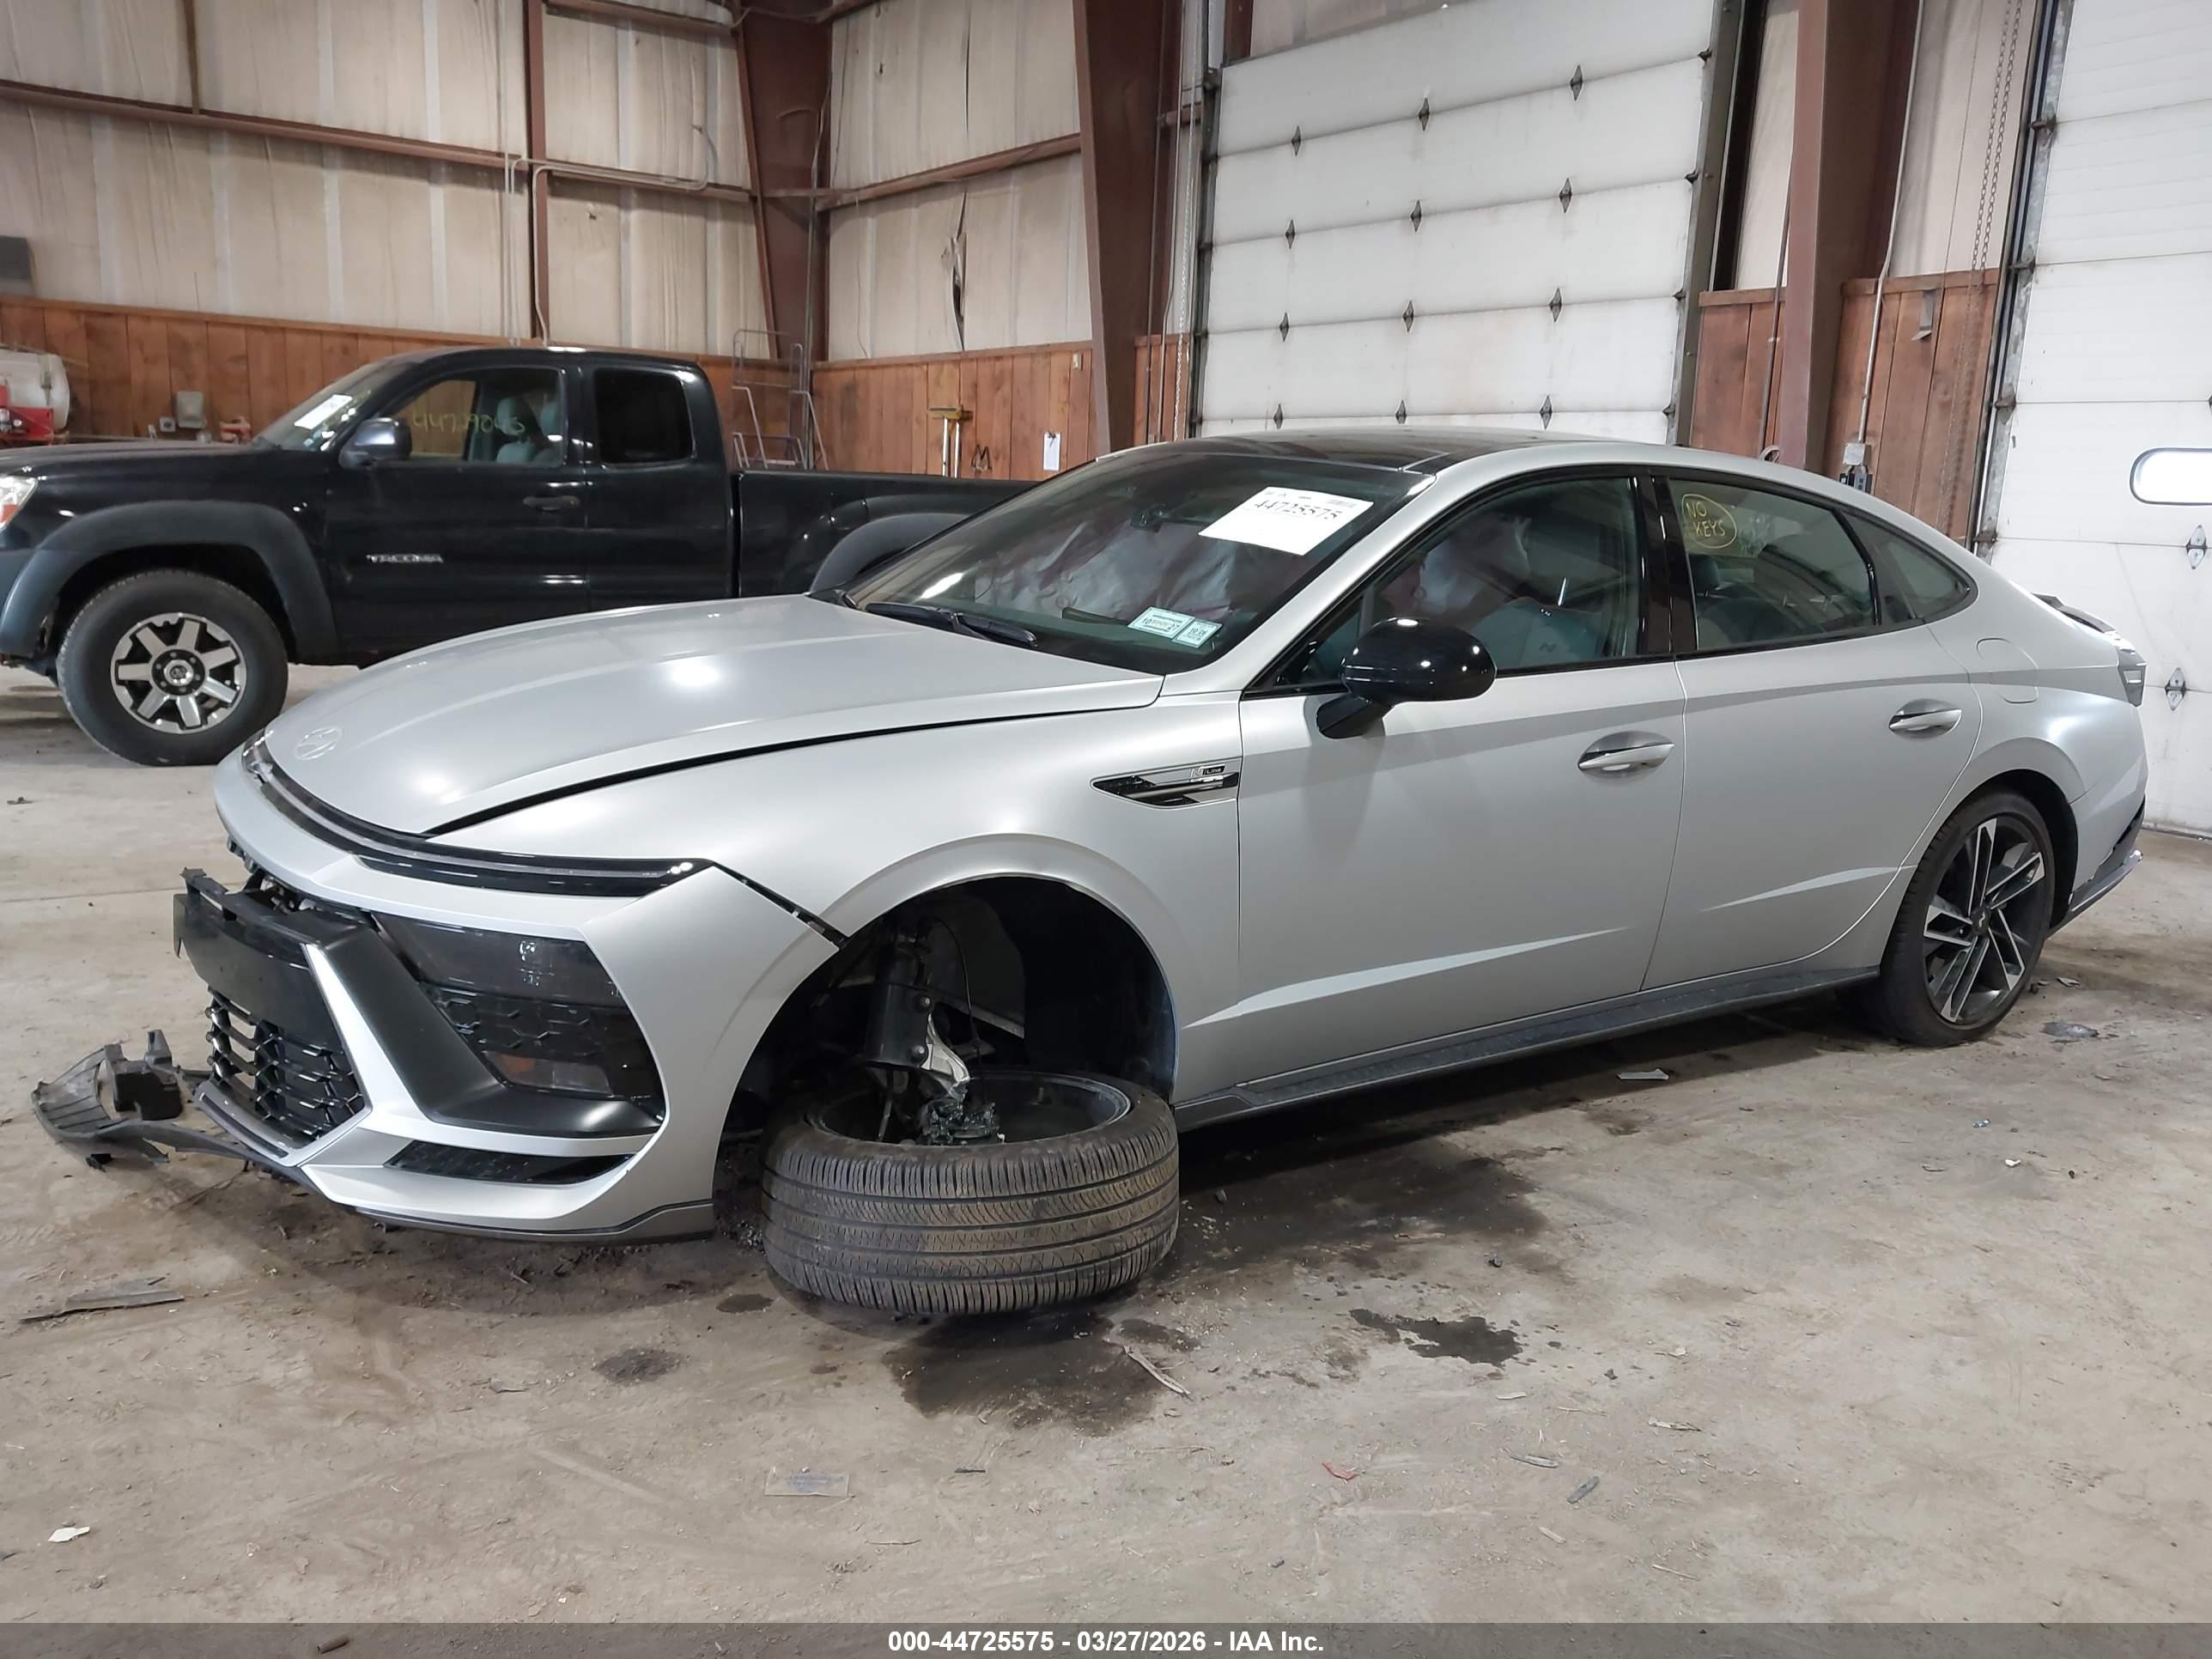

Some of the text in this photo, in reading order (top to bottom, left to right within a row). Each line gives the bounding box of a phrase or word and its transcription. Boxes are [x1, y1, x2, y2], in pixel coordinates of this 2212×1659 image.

[1254, 499, 1343, 520] 44725575
[1686, 501, 1707, 519] NO
[1692, 519, 1726, 538] KEYS
